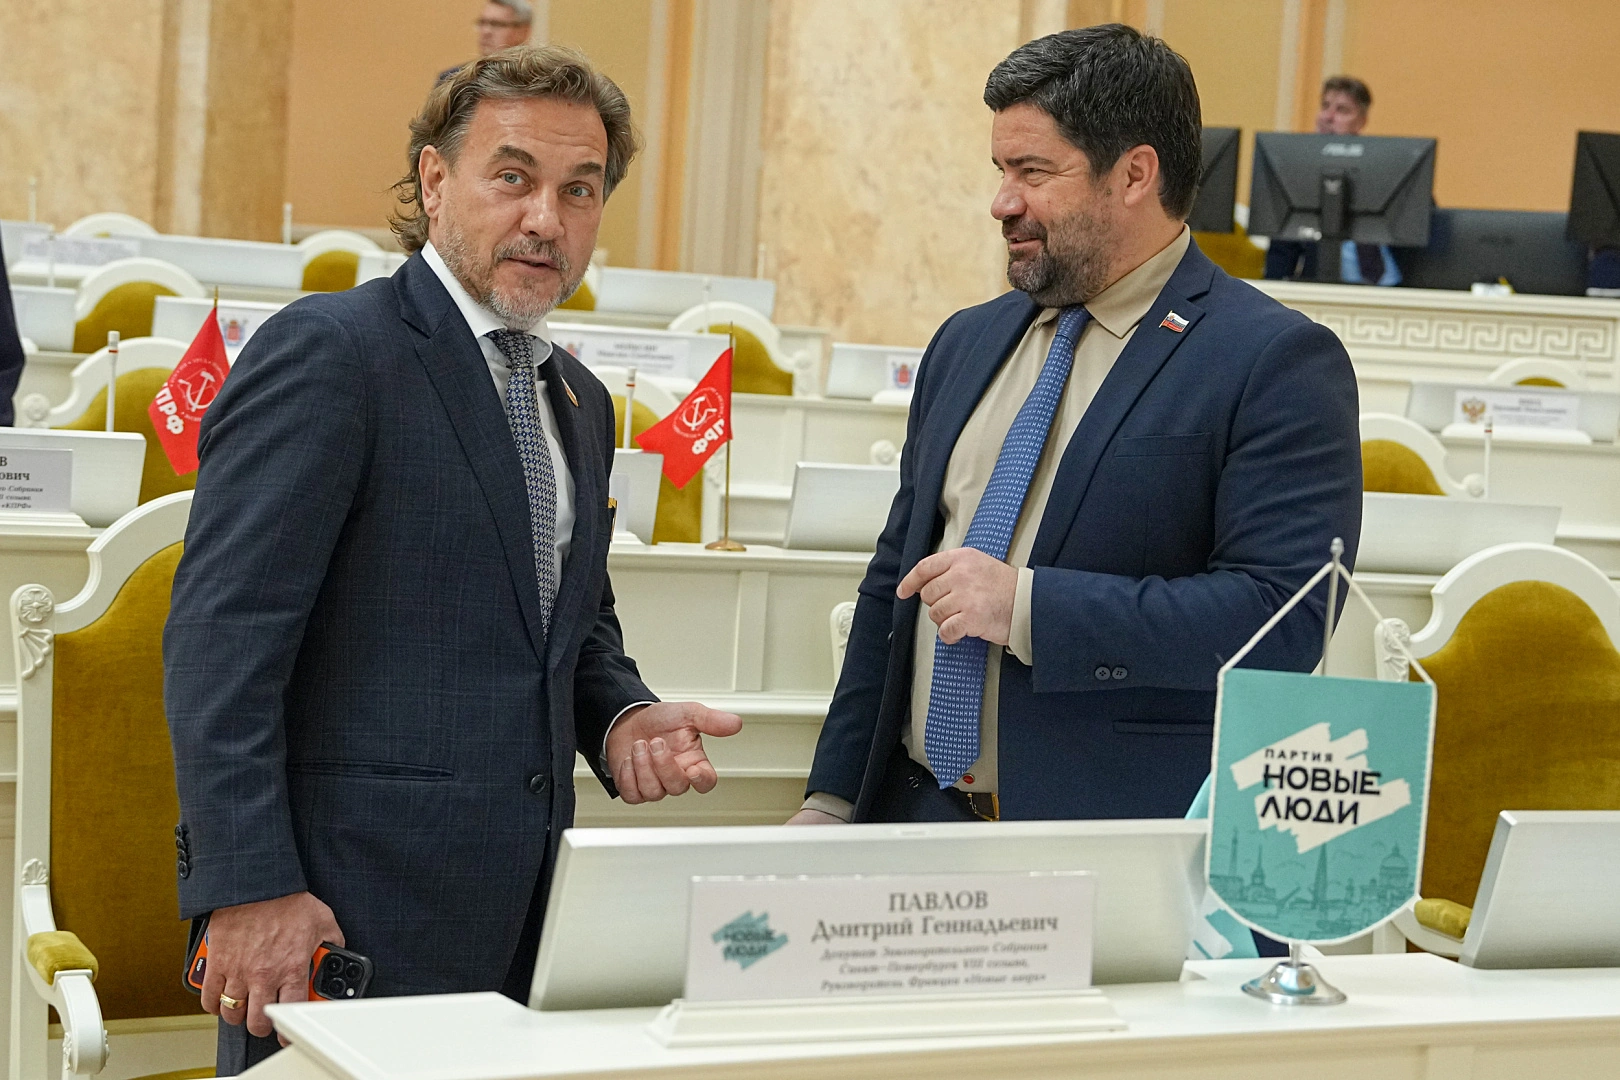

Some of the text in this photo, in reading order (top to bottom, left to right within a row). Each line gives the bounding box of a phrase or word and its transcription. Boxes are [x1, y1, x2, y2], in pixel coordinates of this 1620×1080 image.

[155, 382, 184, 435] ПРФ
[0, 472, 30, 481] ович
[1265, 748, 1333, 762] ПАРТИЯ
[1263, 764, 1381, 795] НОВЫЕ
[1260, 796, 1359, 825] ЛЮДИ
[888, 890, 989, 913] ПАВЛОВ
[811, 915, 1059, 943] Дмитрий Геннадьевич
